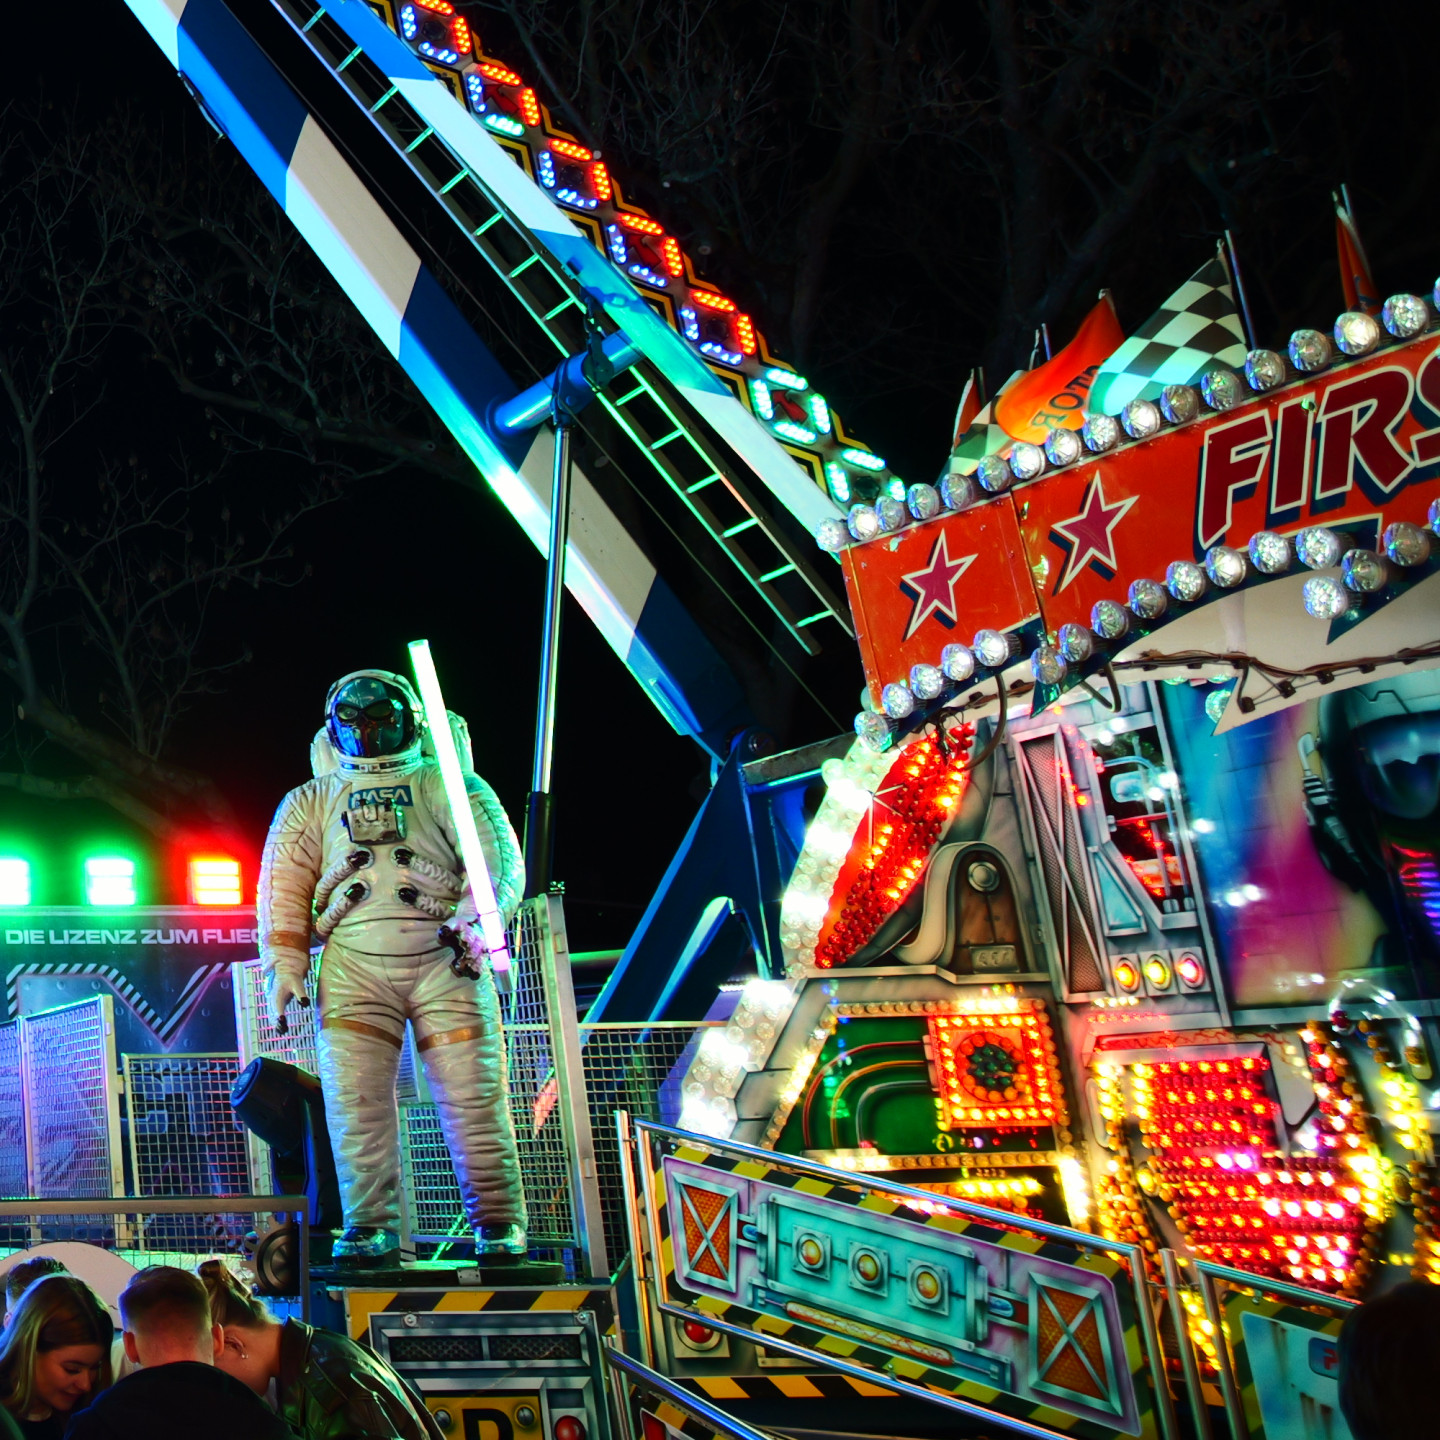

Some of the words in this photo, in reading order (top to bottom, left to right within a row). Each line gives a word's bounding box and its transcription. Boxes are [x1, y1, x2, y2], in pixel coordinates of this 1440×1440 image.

[351, 787, 409, 809] NASA
[5, 929, 36, 944] DIE
[49, 929, 138, 944] LIZENZ
[141, 929, 199, 944] ZUM
